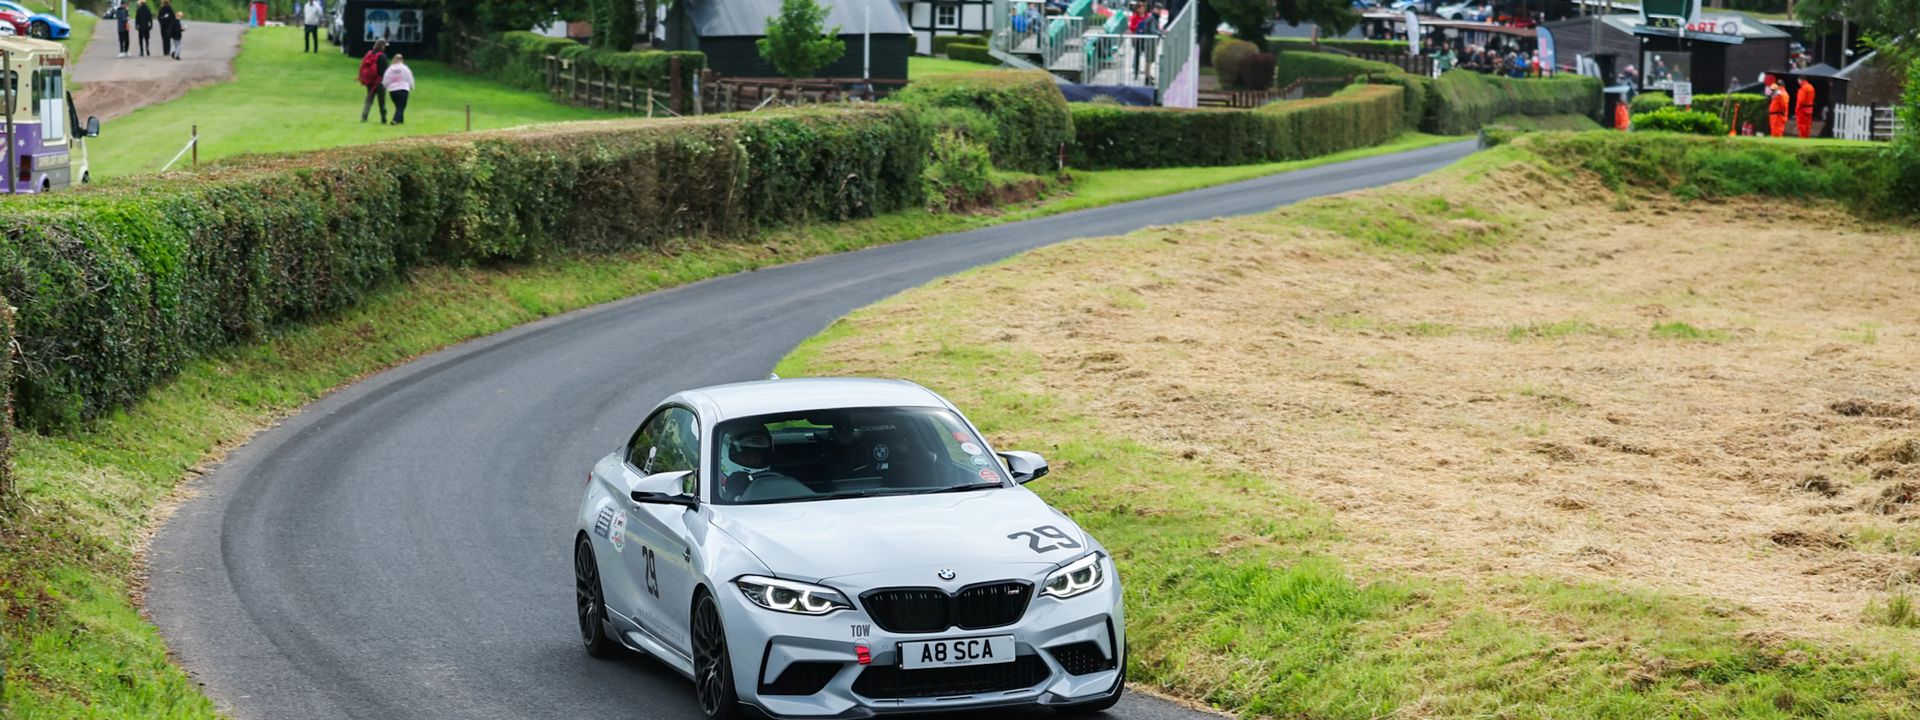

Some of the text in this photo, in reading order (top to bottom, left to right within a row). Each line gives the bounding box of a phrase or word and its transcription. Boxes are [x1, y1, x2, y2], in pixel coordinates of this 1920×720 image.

[1687, 21, 1717, 33] ART
[1007, 525, 1082, 554] 29
[642, 545, 660, 600] 29
[851, 624, 870, 637] TOW
[921, 639, 993, 663] A8 SCA
